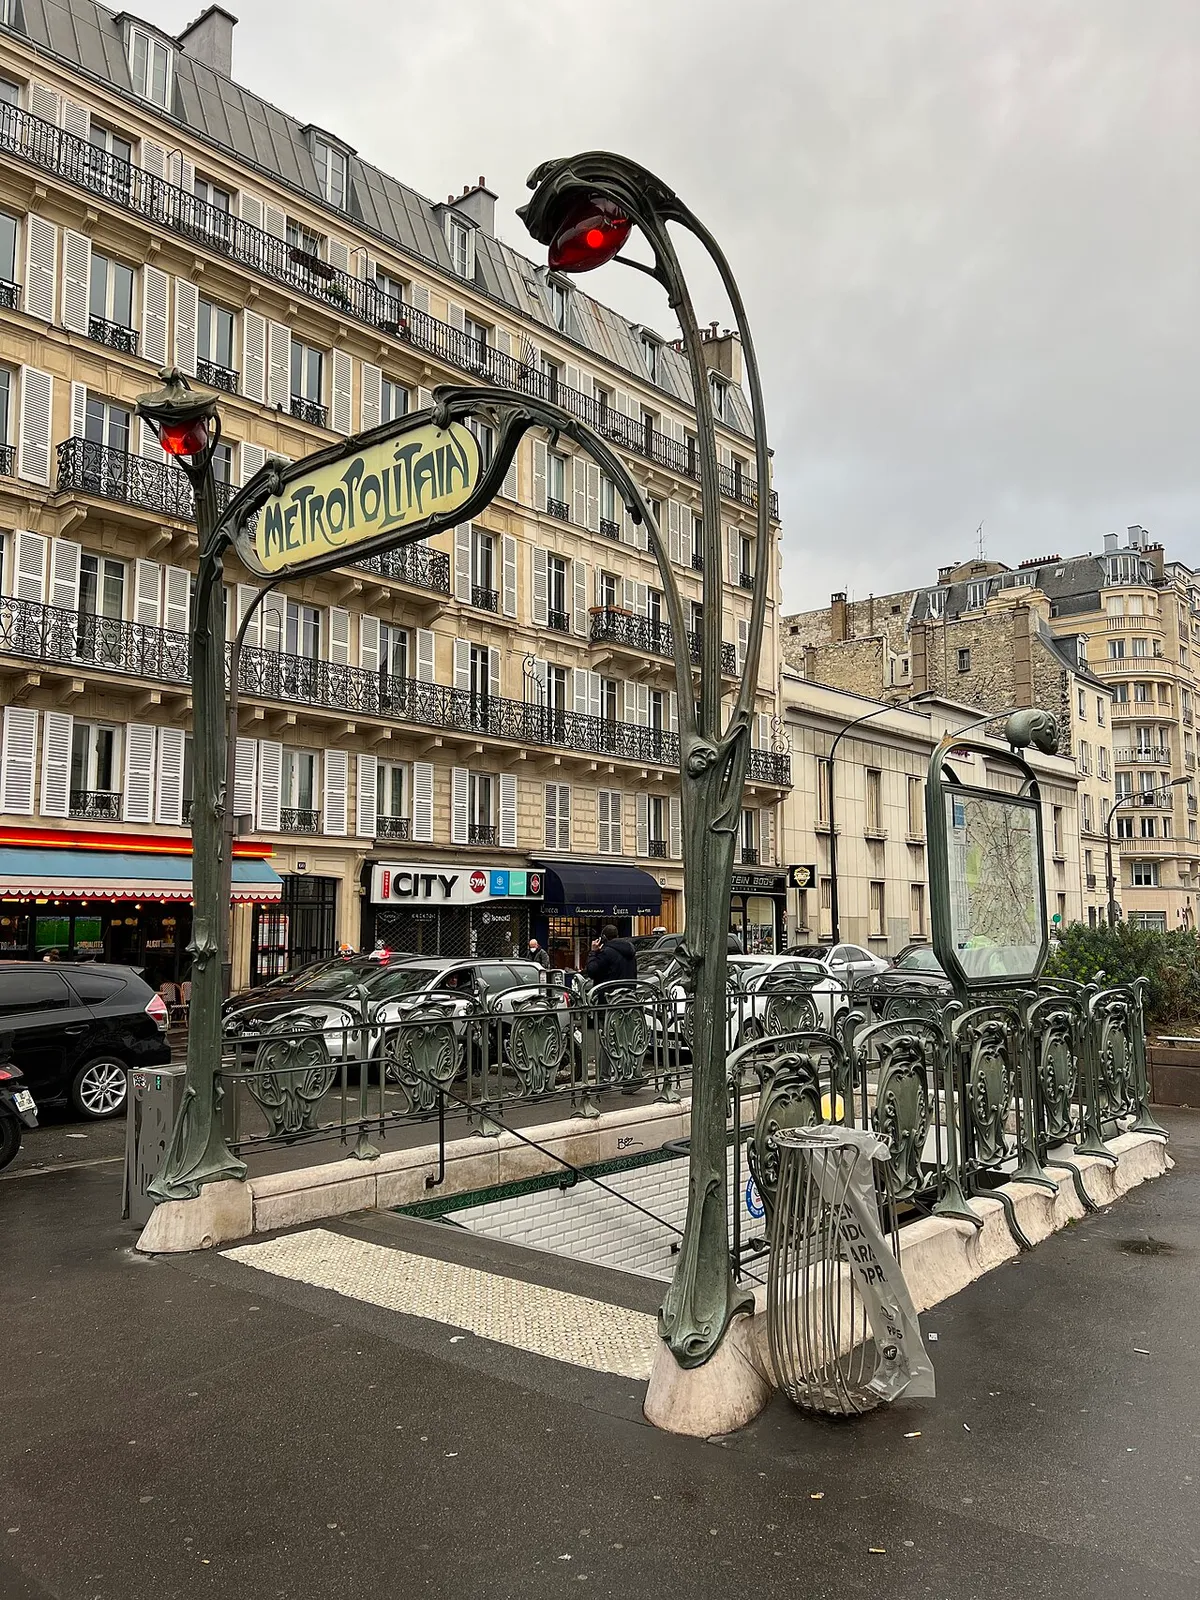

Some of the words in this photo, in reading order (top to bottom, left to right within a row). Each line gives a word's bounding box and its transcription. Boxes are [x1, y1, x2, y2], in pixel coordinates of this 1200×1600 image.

[264, 429, 469, 558] METROPOLITAIN
[393, 872, 459, 898] CITY
[469, 877, 486, 889] SYM
[753, 876, 774, 886] BODY
